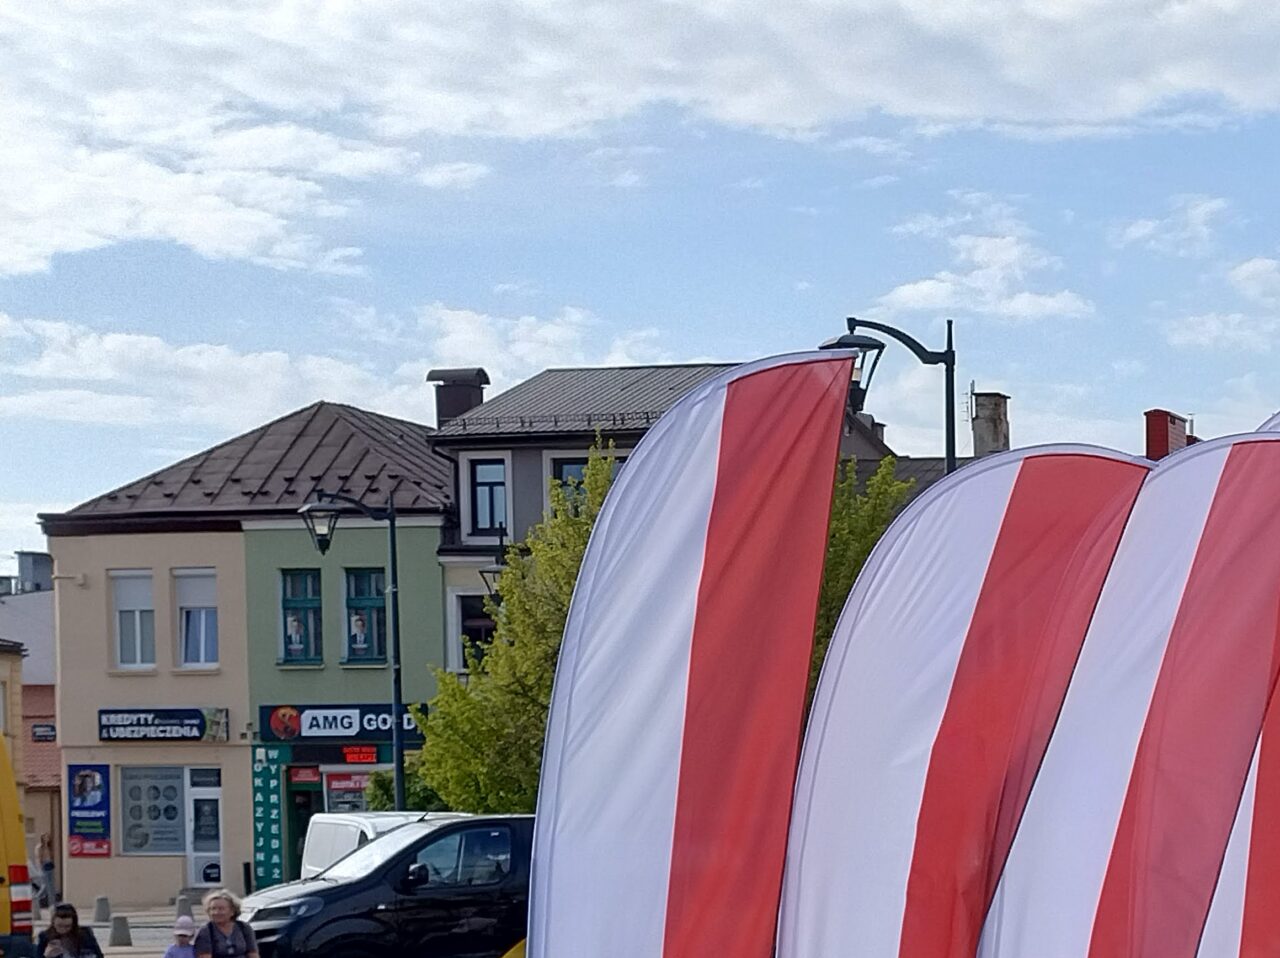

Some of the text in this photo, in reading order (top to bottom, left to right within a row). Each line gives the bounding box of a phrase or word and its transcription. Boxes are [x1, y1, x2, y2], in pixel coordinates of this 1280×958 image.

[101, 713, 155, 725] KREDYTY
[308, 713, 416, 730] AMG GOD
[109, 726, 200, 738] UBEZPIECZENIA
